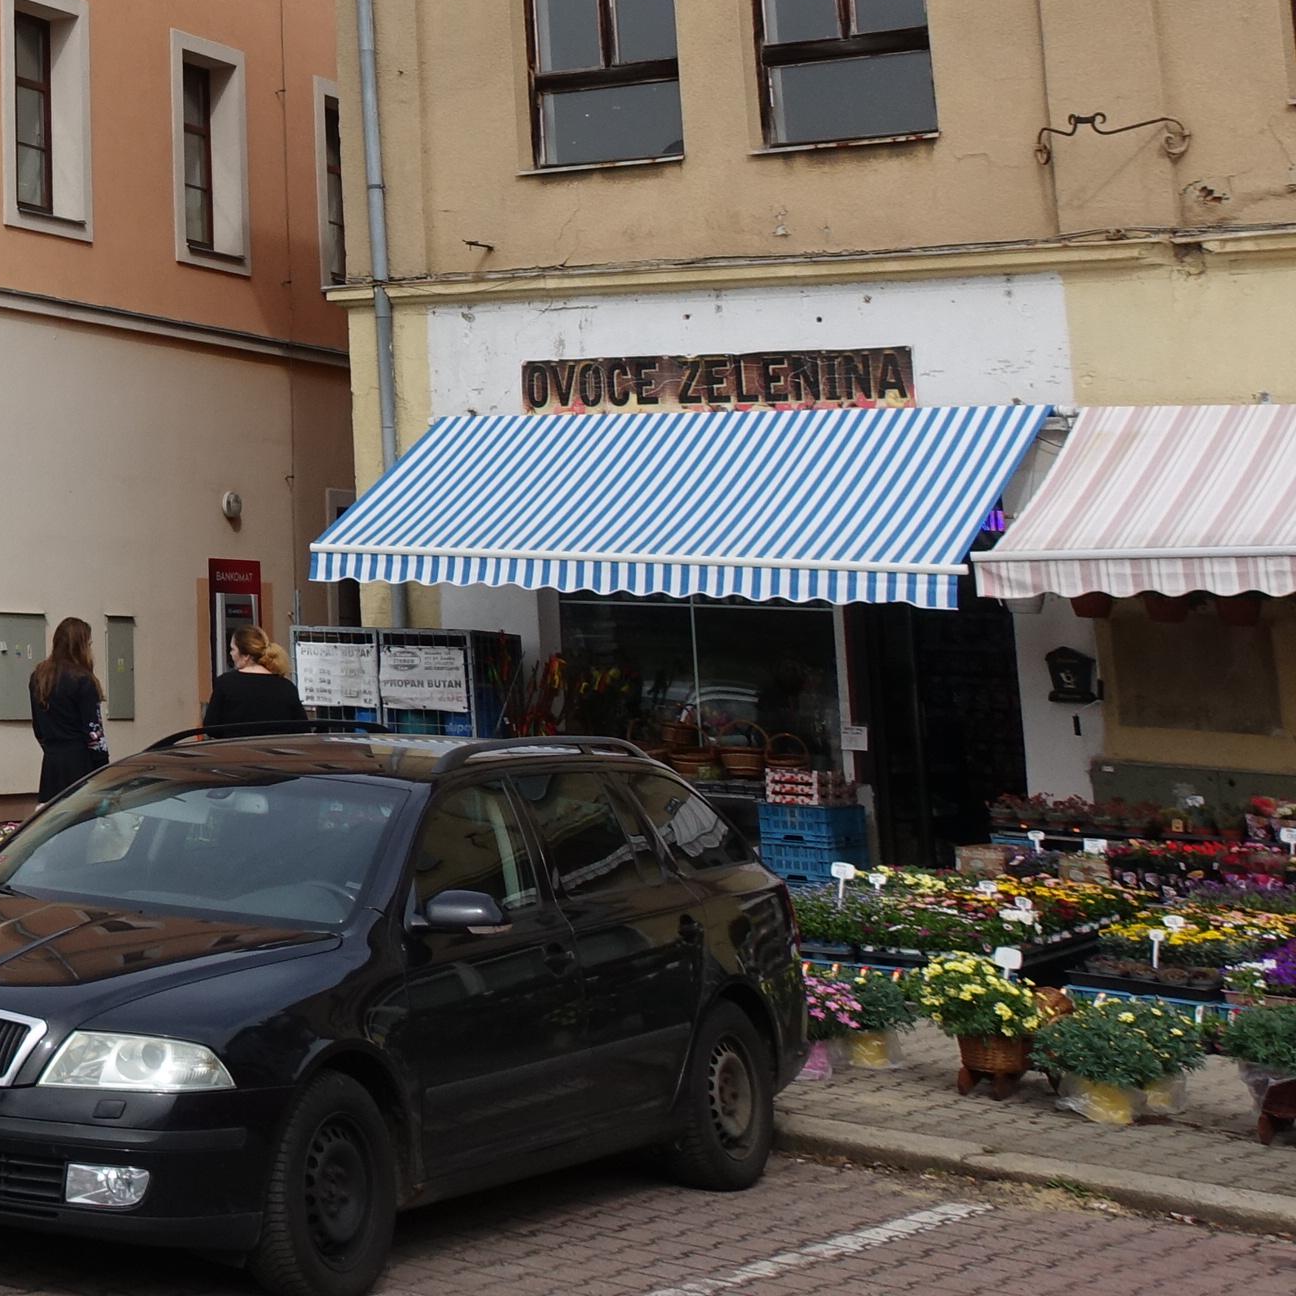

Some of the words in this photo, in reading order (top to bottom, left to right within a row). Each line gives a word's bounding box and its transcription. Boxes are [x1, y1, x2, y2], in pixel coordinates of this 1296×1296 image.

[527, 360, 660, 408] OVOCE
[678, 351, 908, 405] ZELENINA
[216, 571, 253, 582] BANKOMAT
[383, 679, 424, 688] PROPAN
[427, 680, 462, 689] BUTAN
